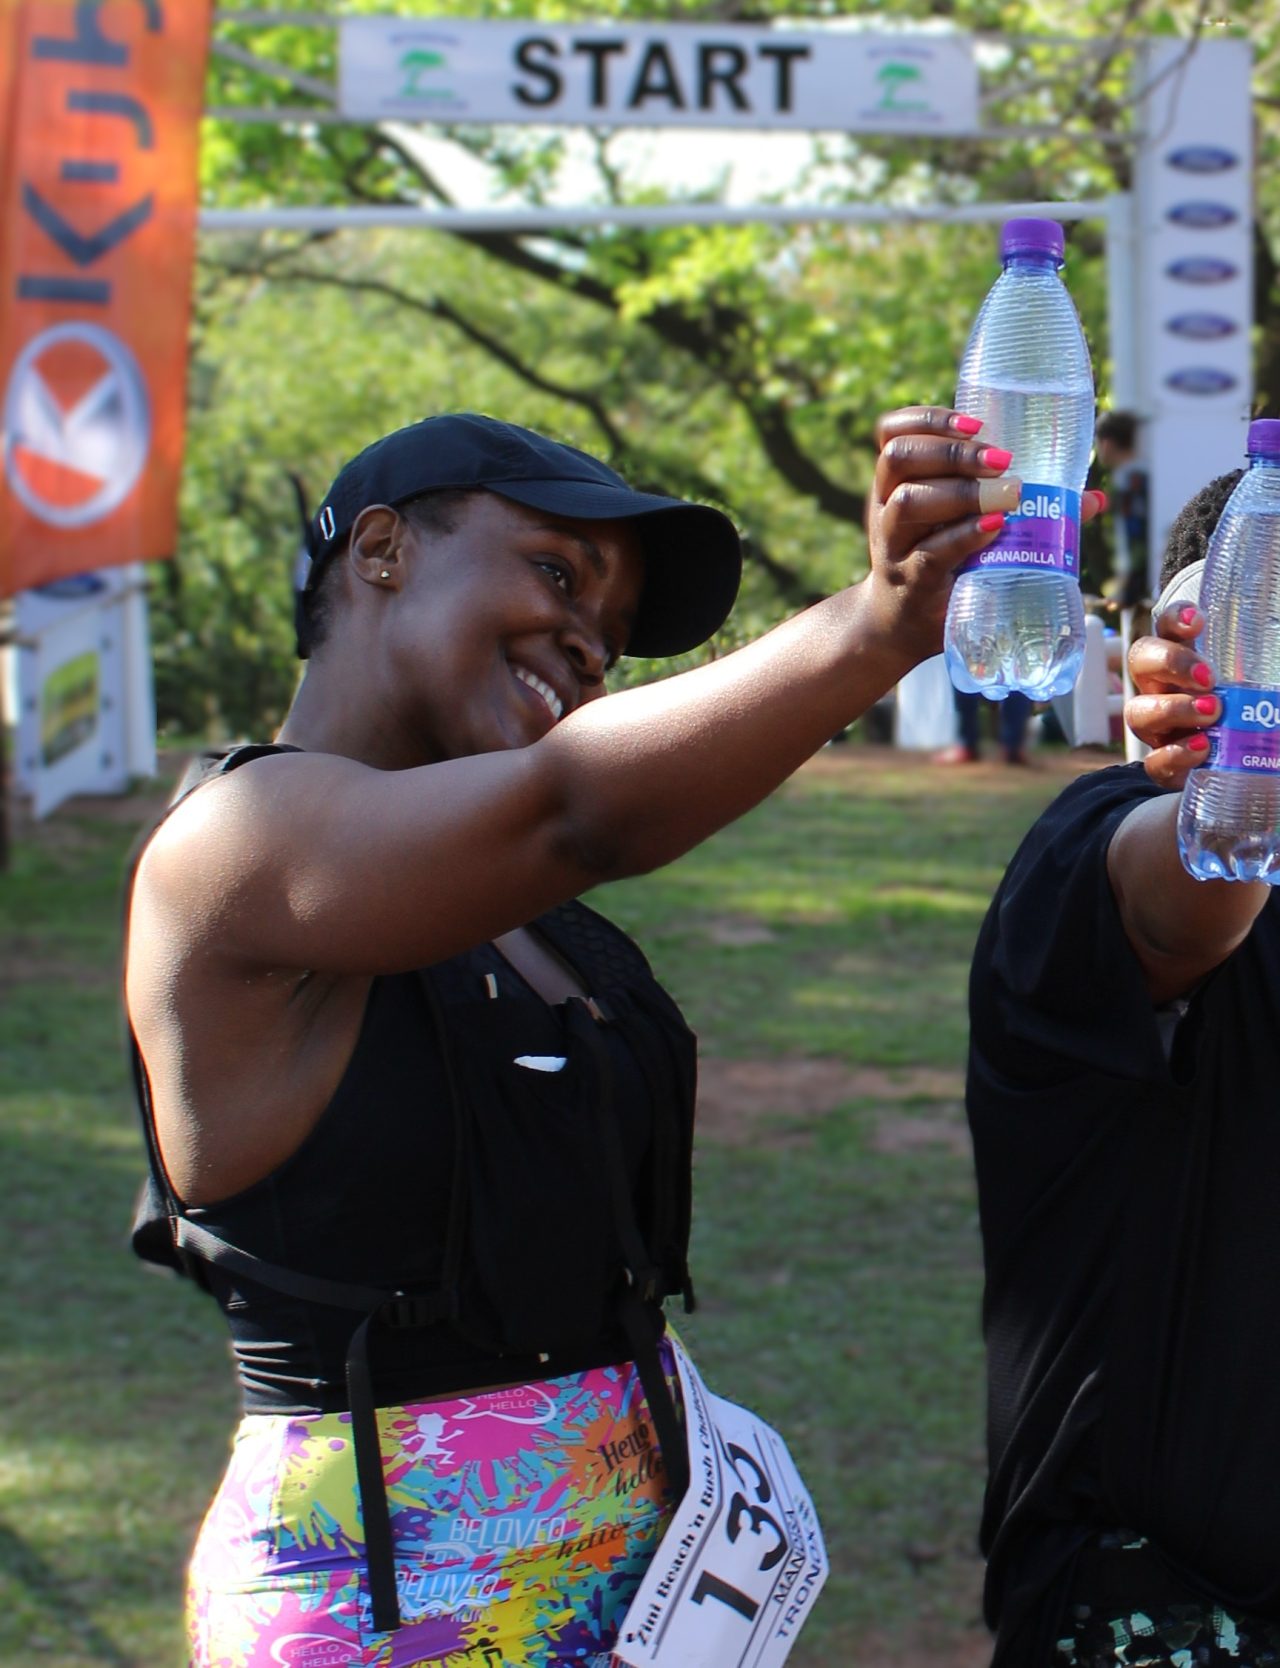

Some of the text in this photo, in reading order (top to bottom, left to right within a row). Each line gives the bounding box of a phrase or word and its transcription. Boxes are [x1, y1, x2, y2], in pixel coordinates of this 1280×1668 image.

[510, 36, 811, 113] START
[980, 550, 1055, 565] GRANADILLA
[490, 1399, 537, 1411] HELLO
[450, 1516, 567, 1549] BELOVED
[637, 1602, 661, 1647] Zini
[656, 1536, 695, 1599] Beach
[700, 1456, 718, 1509] Bush
